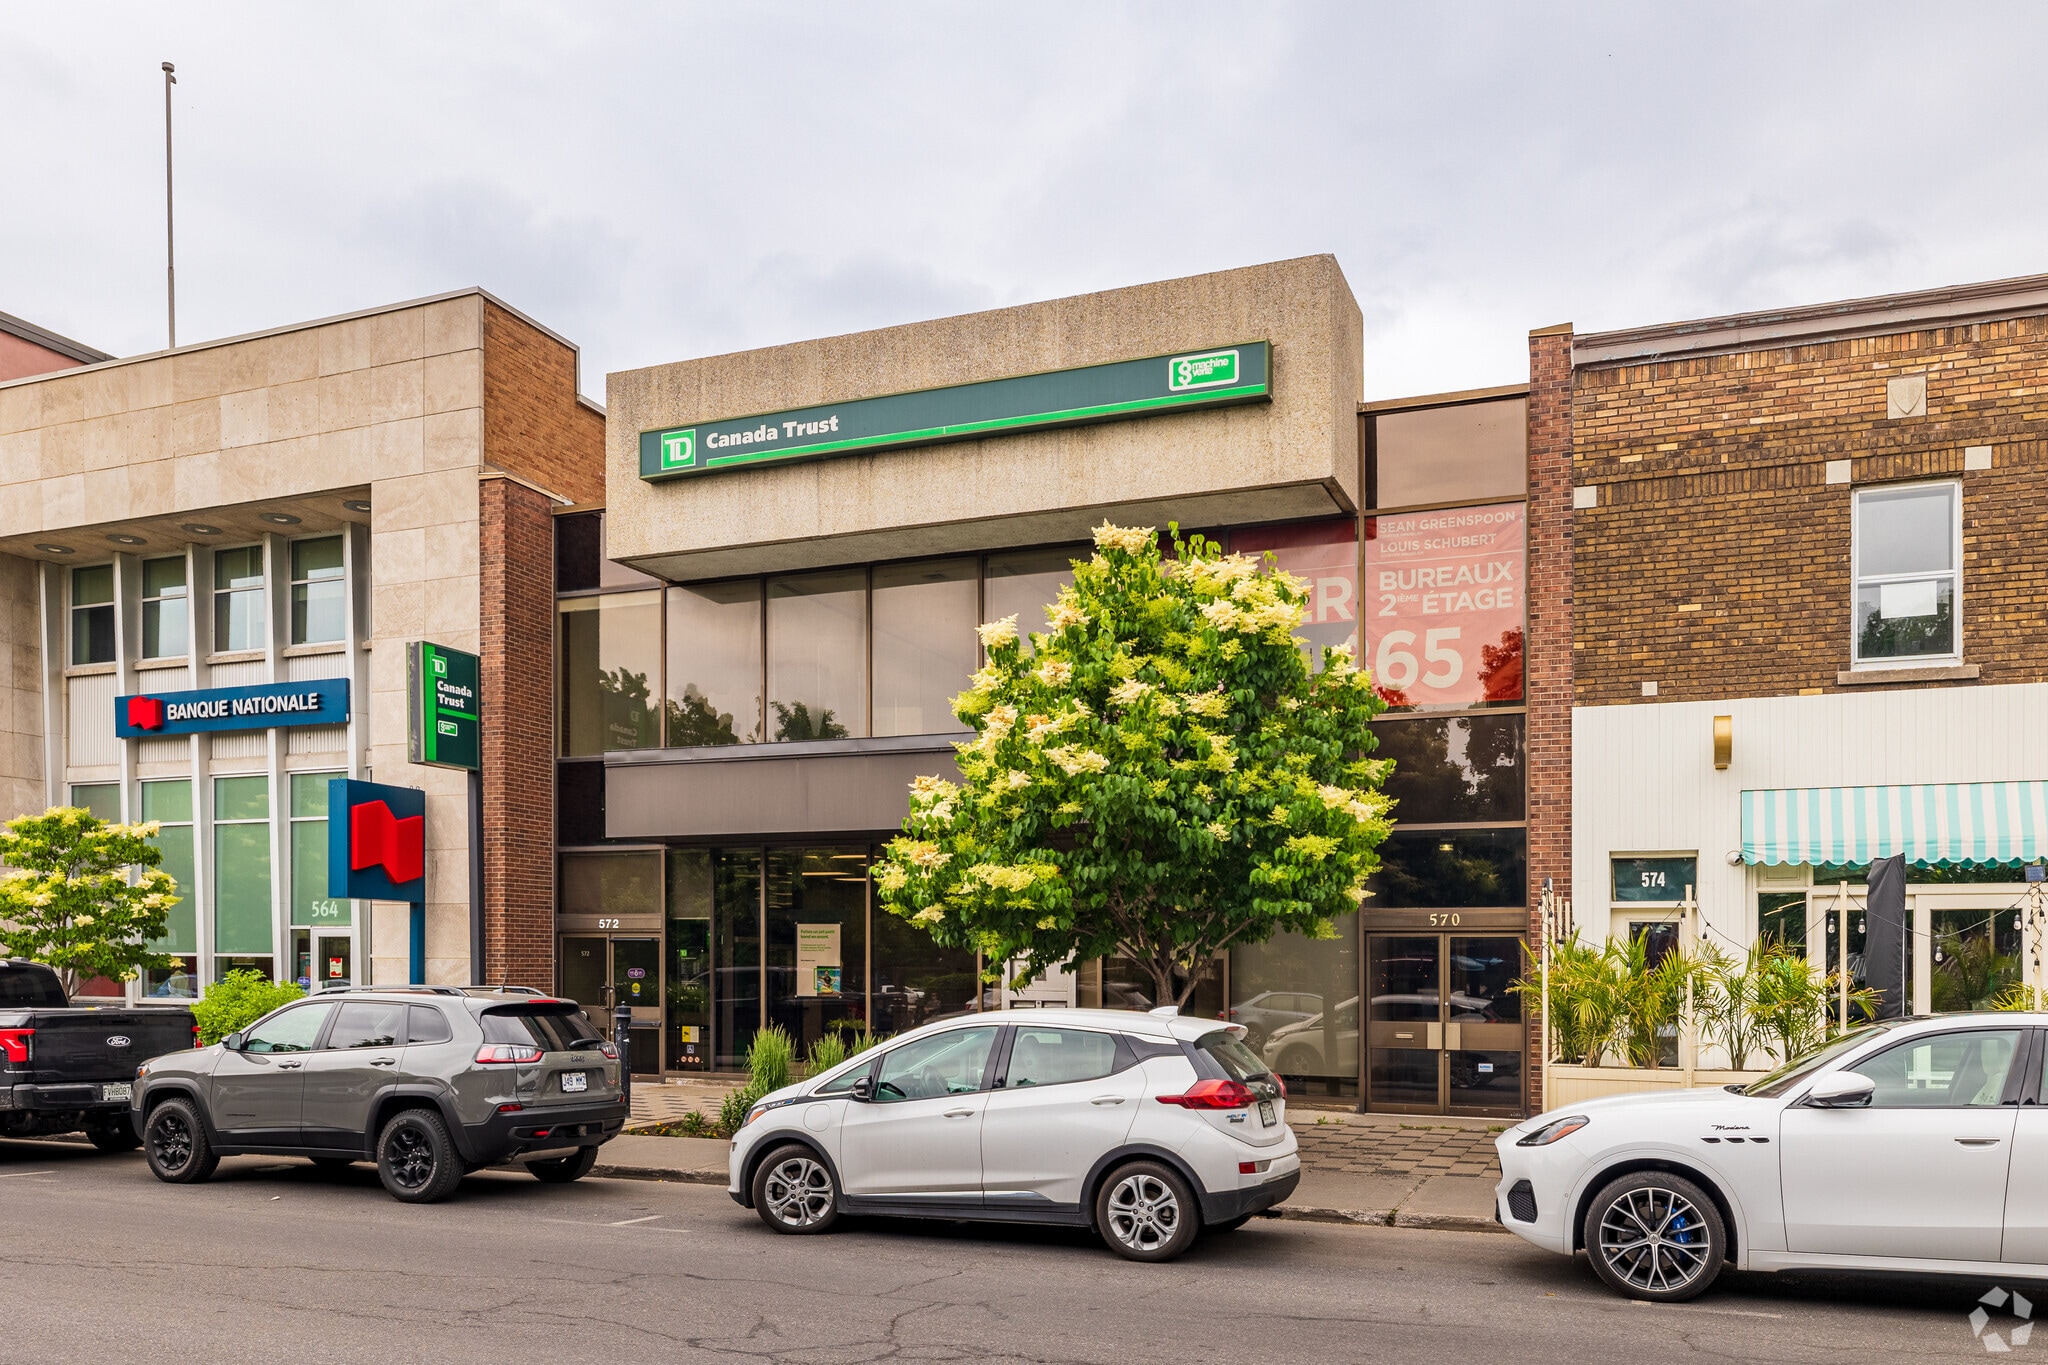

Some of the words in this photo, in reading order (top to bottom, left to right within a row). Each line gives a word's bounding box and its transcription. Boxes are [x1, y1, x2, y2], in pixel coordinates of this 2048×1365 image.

[1192, 358, 1229, 370] machine
[664, 437, 692, 462] TD
[706, 424, 778, 449] Canada
[782, 415, 839, 438] Trust
[1379, 520, 1415, 534] SEAN
[1420, 511, 1516, 530] GREENSPOON
[1380, 540, 1420, 553] LOUIS
[1424, 533, 1497, 550] SCHUBERT
[1379, 561, 1513, 591] BUREAUX
[1422, 587, 1514, 614] ÉTAGE
[432, 658, 446, 674] TD
[437, 680, 472, 698] Canada
[167, 699, 228, 720] BANQUE
[232, 692, 318, 716] NATIONALE
[437, 693, 465, 709] Trust
[1641, 871, 1666, 888] 574
[311, 900, 338, 918] 564
[598, 918, 619, 929] 572
[1429, 913, 1460, 926] 570
